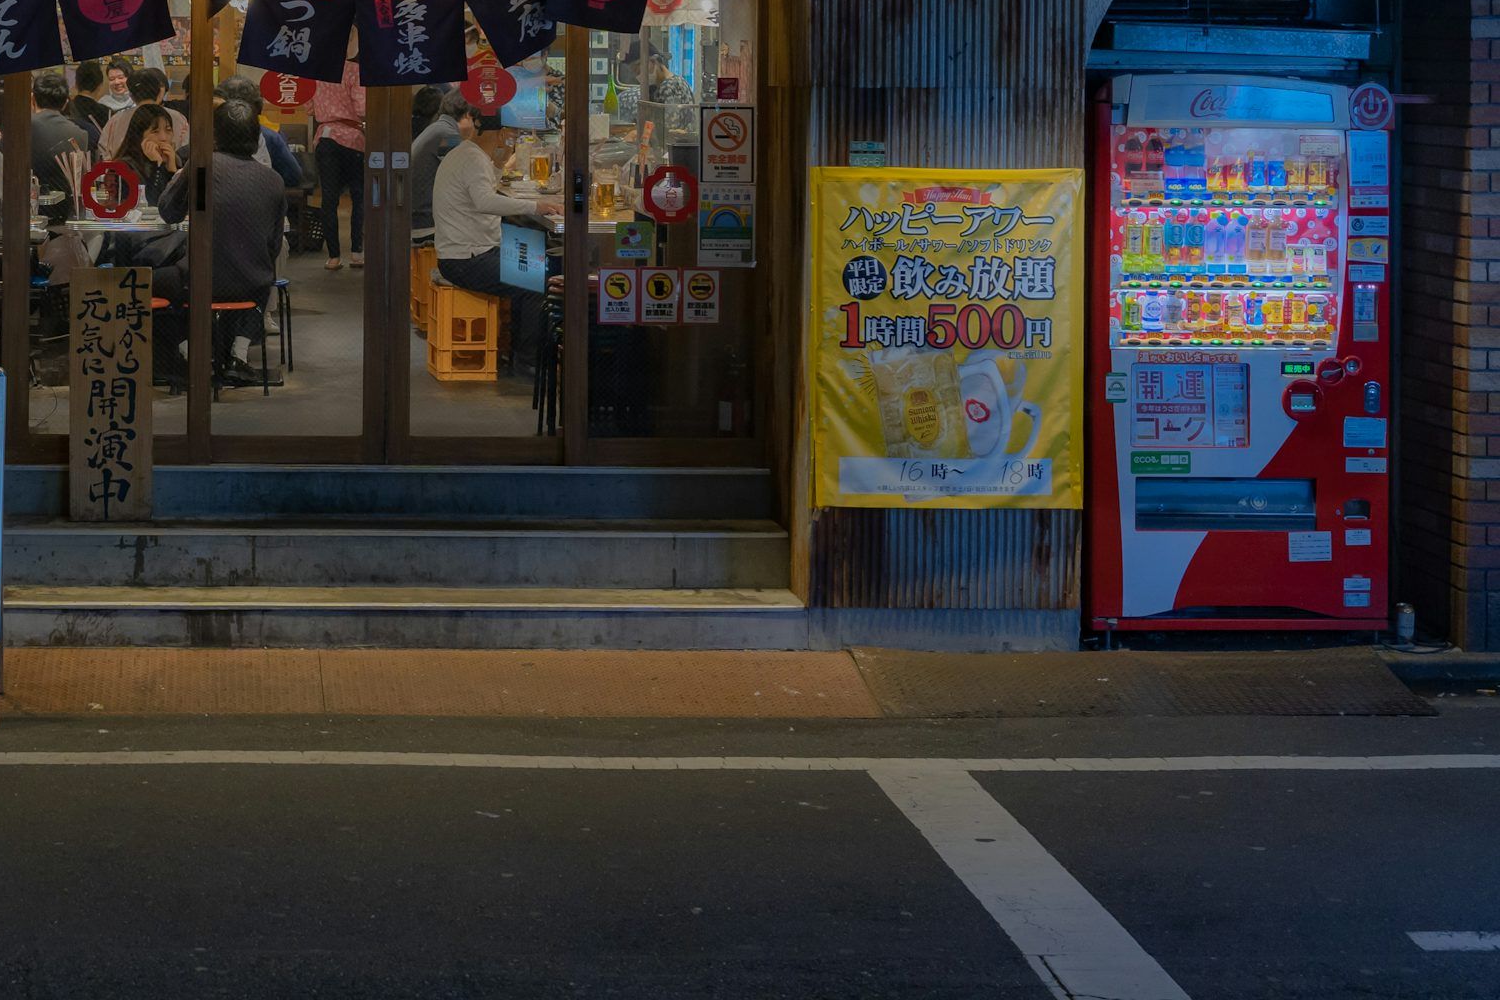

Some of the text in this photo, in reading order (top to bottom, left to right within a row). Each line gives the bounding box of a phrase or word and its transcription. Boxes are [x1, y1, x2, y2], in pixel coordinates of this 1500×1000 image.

[839, 203, 1055, 237] ハッピーアワー
[848, 260, 880, 275] 平日
[849, 277, 886, 296] 限定
[891, 255, 1057, 301] 飲み放題
[76, 290, 115, 375] 元気に
[115, 268, 151, 375] 4時から
[84, 376, 136, 524] 開演中
